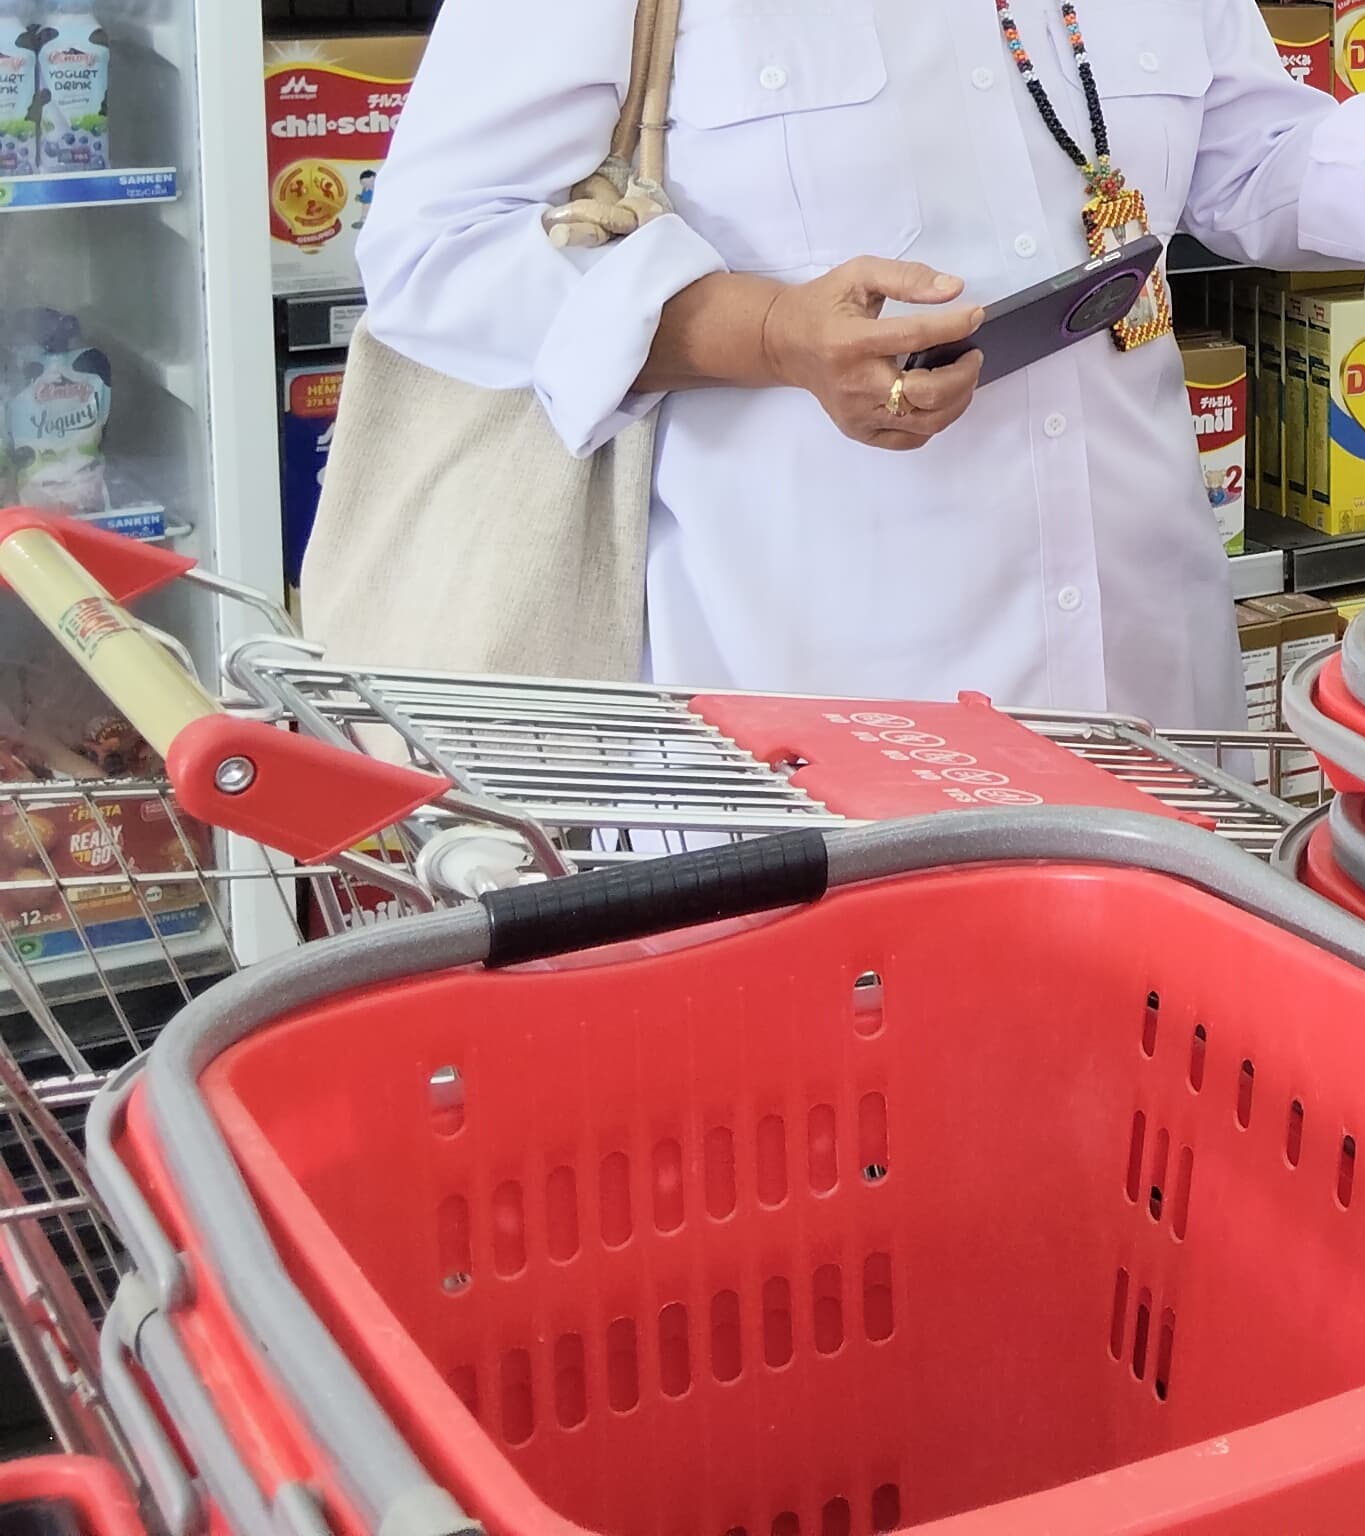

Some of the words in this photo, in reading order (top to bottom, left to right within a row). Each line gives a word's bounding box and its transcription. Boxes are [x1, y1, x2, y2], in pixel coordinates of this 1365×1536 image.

[49, 69, 98, 79] YOGURT
[119, 174, 172, 185] SANKEN
[107, 515, 160, 529] SANKEN
[20, 911, 41, 926] 12
